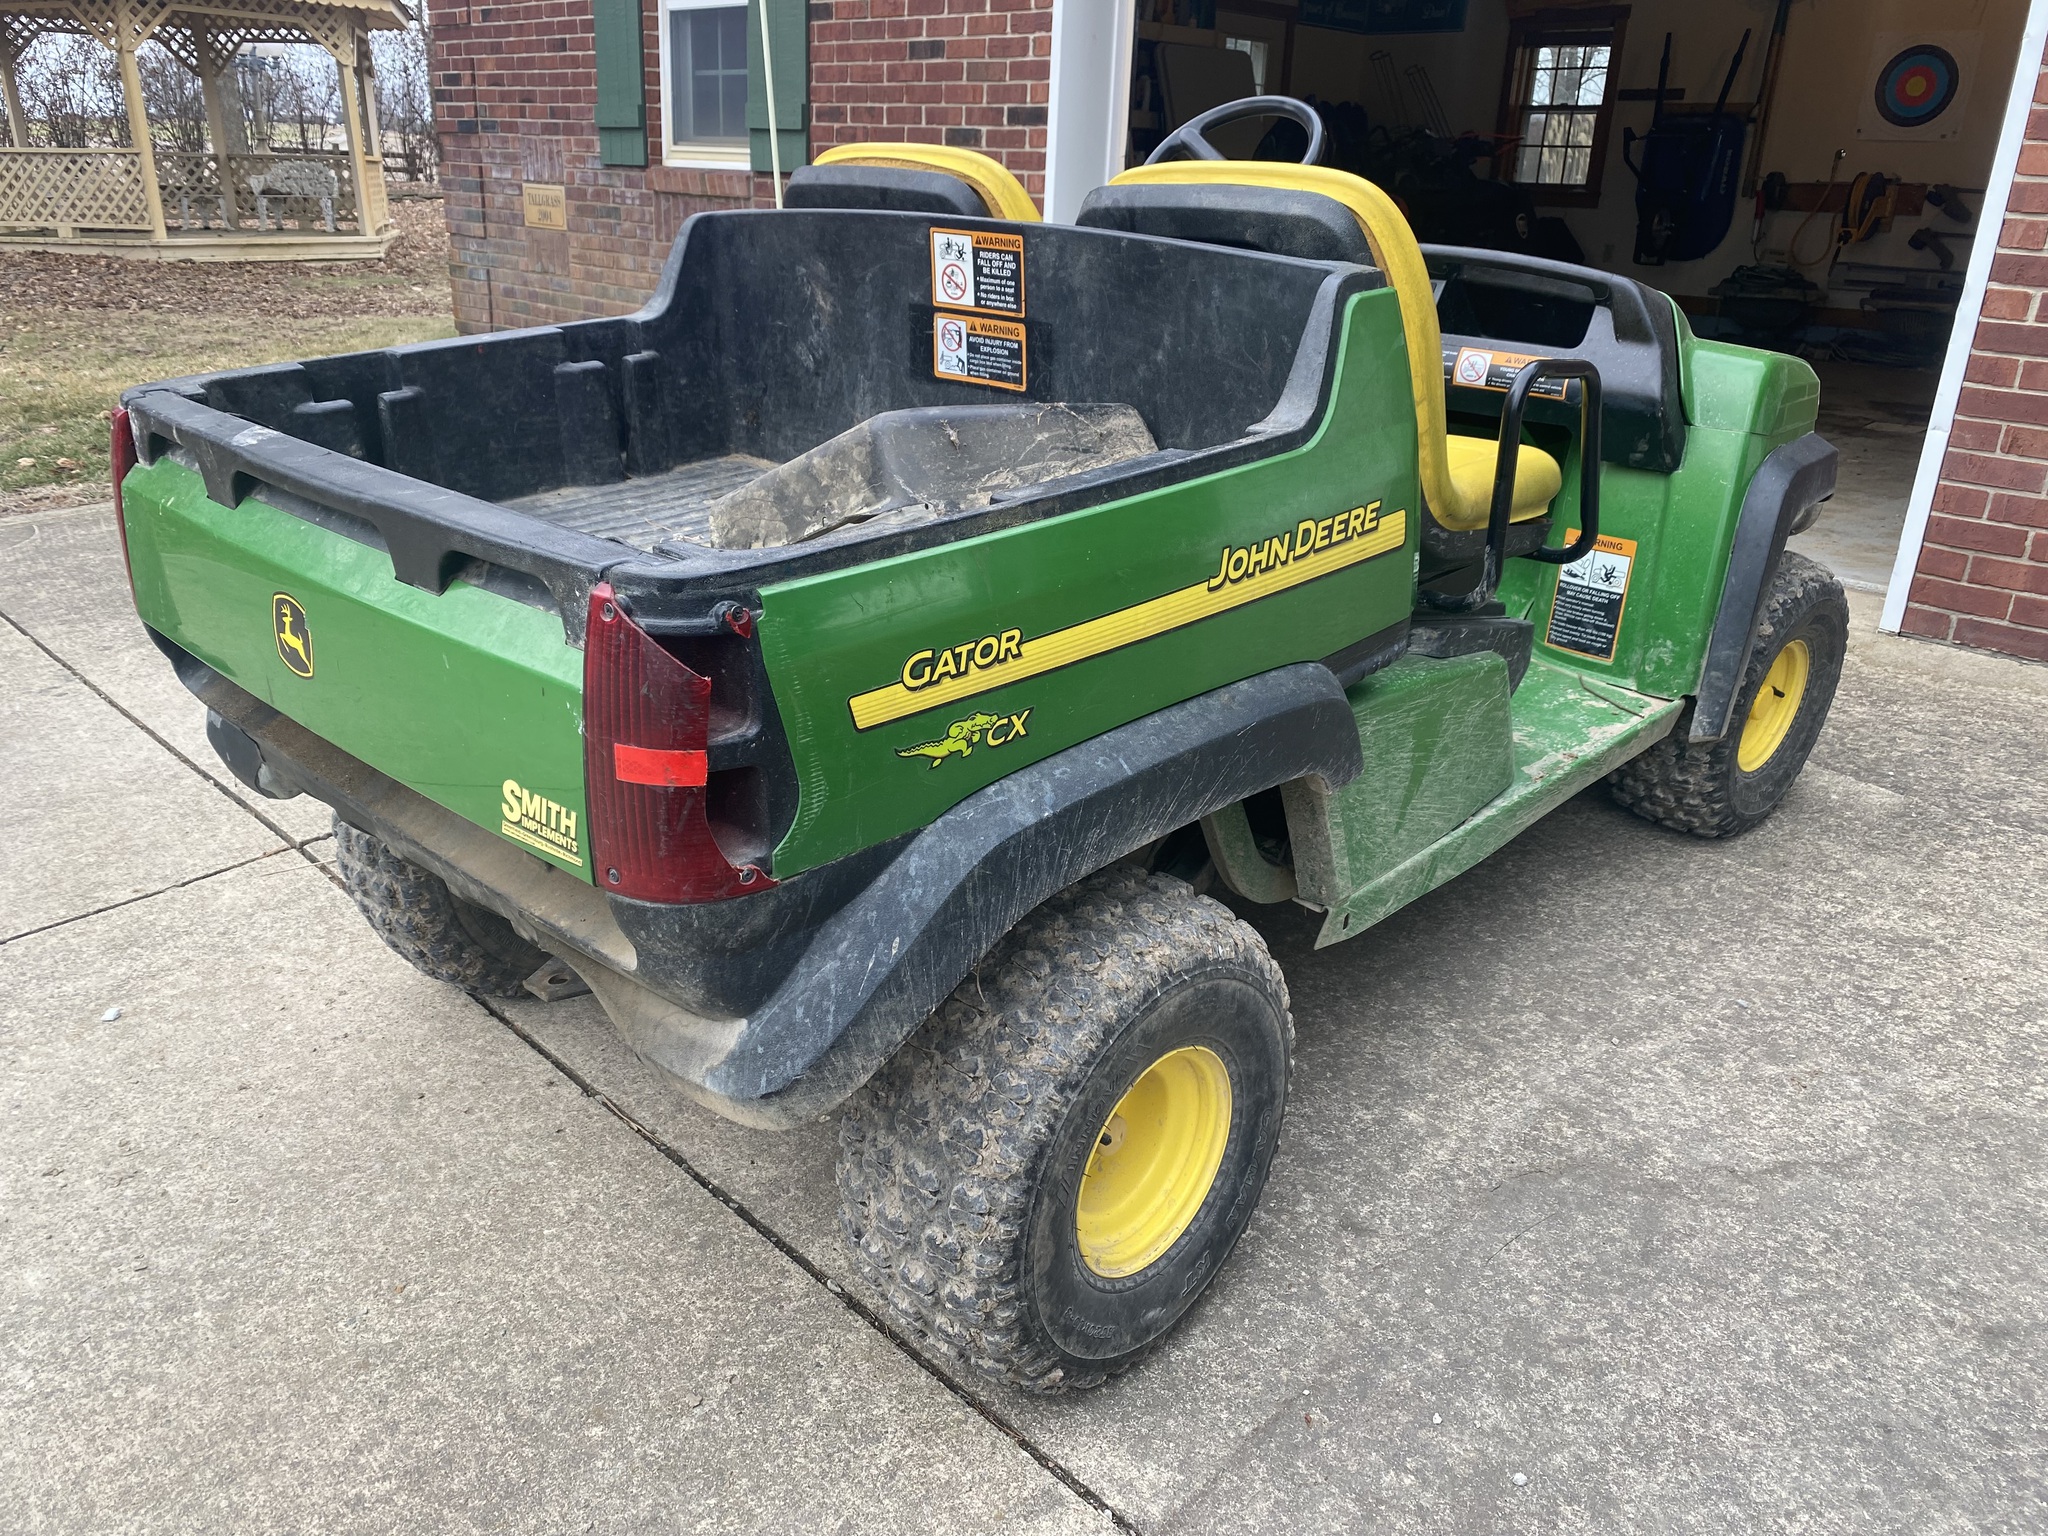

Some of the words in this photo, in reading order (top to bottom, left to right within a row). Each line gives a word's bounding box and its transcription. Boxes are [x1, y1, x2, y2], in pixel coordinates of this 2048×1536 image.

[527, 193, 561, 208] TALLGRASS
[982, 236, 1020, 248] WARNING
[992, 268, 1011, 276] KILLED
[980, 323, 1019, 337] WARNING
[980, 346, 1008, 356] EXPLOSION
[985, 338, 1002, 346] INJURY
[1004, 341, 1018, 349] FROM
[1208, 531, 1291, 589] JOHN
[1294, 500, 1382, 557] DEERE
[1594, 538, 1623, 551] RNING
[1560, 582, 1582, 592] ROLLOVER
[1589, 589, 1610, 599] FALLING
[1576, 592, 1592, 600] CAUSE
[1592, 596, 1609, 604] DEATH
[902, 628, 1021, 689] GATOR
[986, 709, 1031, 748] CX
[502, 779, 577, 839] SMITH
[521, 815, 578, 853] IMPLEMENTS
[1225, 1107, 1273, 1230] CAYMAN
[1181, 1250, 1212, 1297] KT
